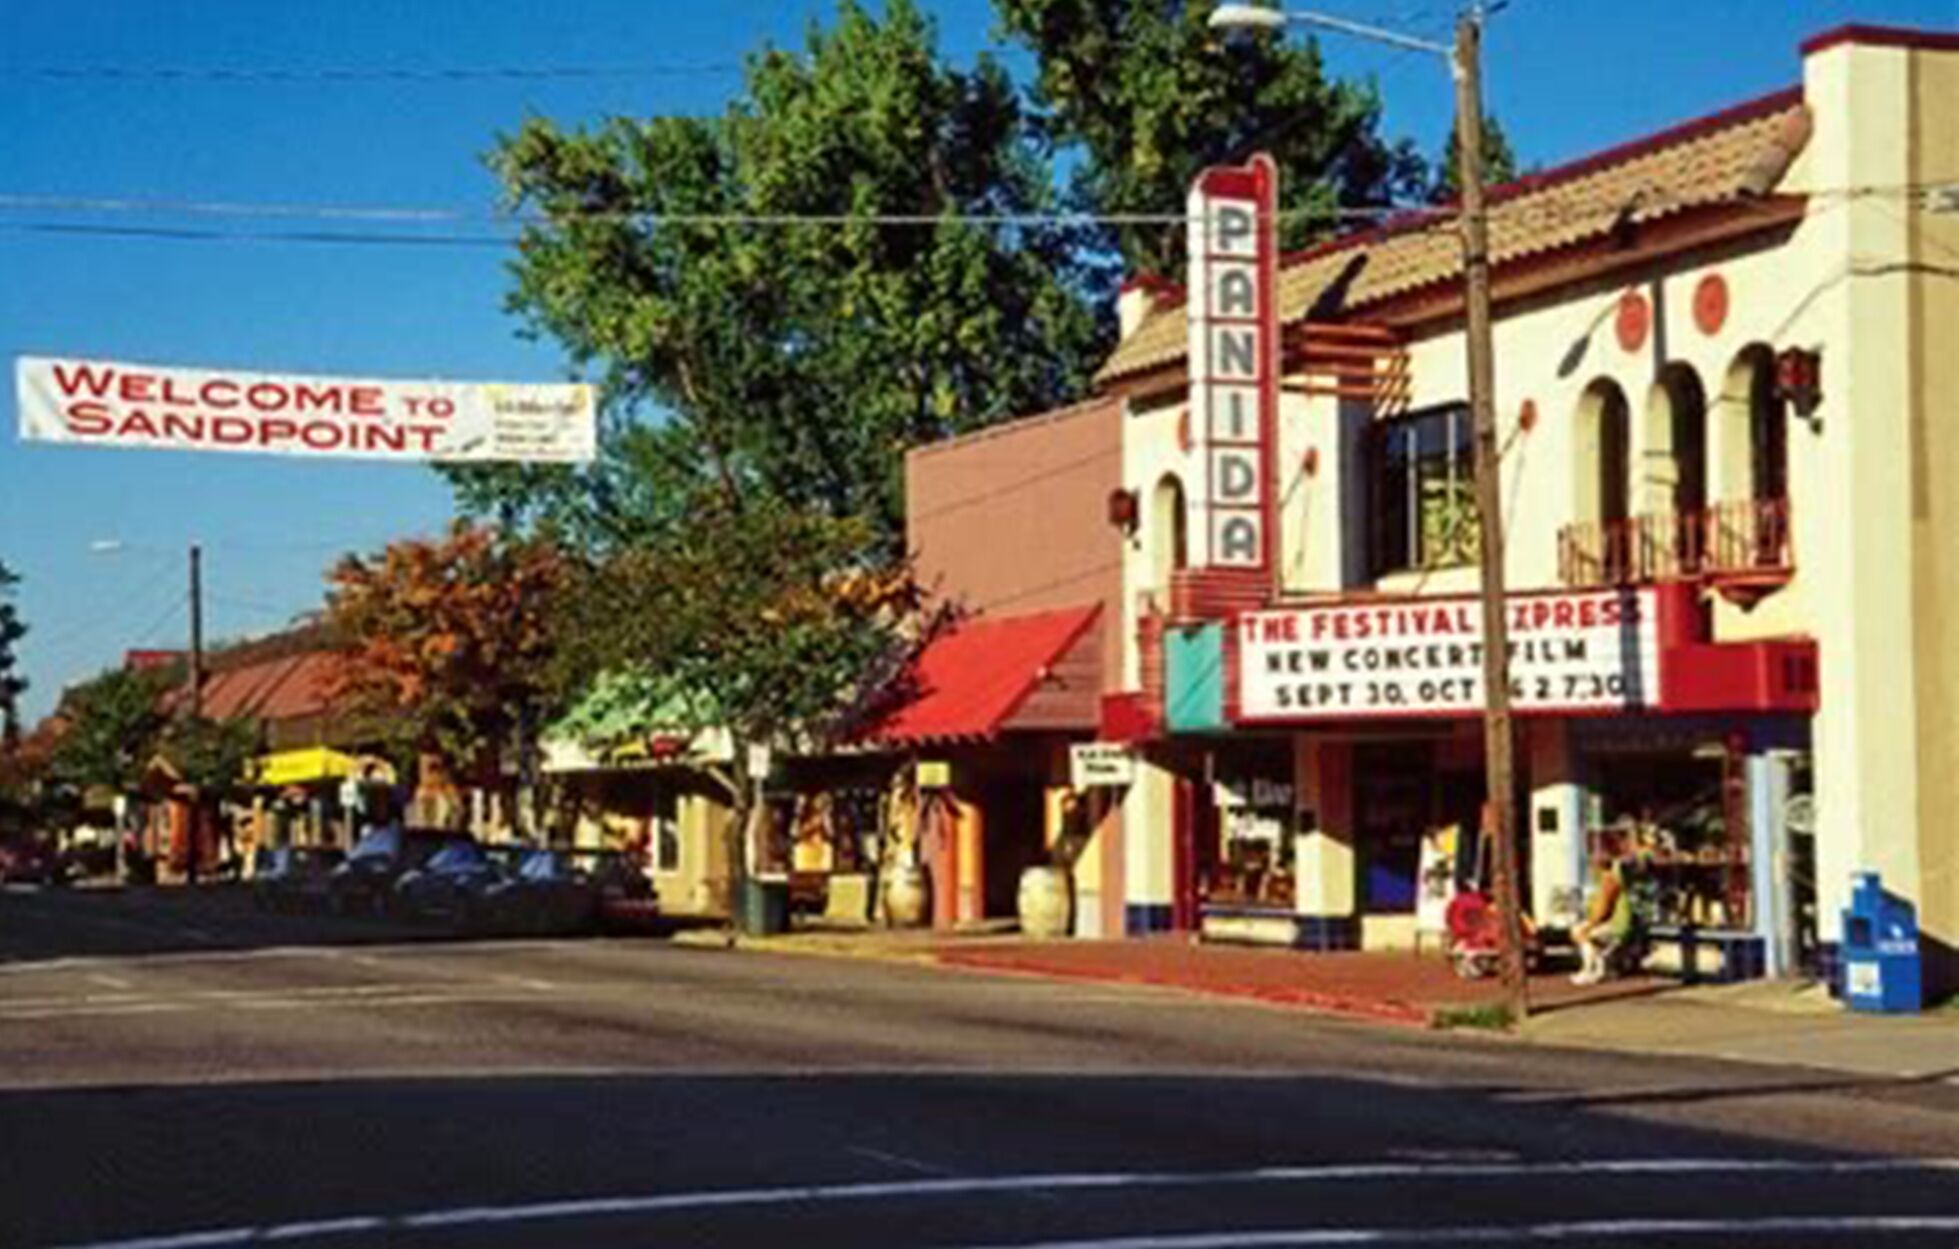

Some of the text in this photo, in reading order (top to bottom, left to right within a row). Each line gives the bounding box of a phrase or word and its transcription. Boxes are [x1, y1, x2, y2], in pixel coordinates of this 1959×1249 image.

[52, 364, 385, 416] WELCOME
[402, 397, 456, 418] TO
[1217, 206, 1256, 561] PANIDA
[66, 401, 447, 452] SANDPOINT
[1243, 598, 1641, 643] THE FESTIVAL XPRESS
[1266, 638, 1586, 673] NEW CONCERT FILM
[1275, 682, 1353, 708] SEPT
[1417, 677, 1475, 703] OCT
